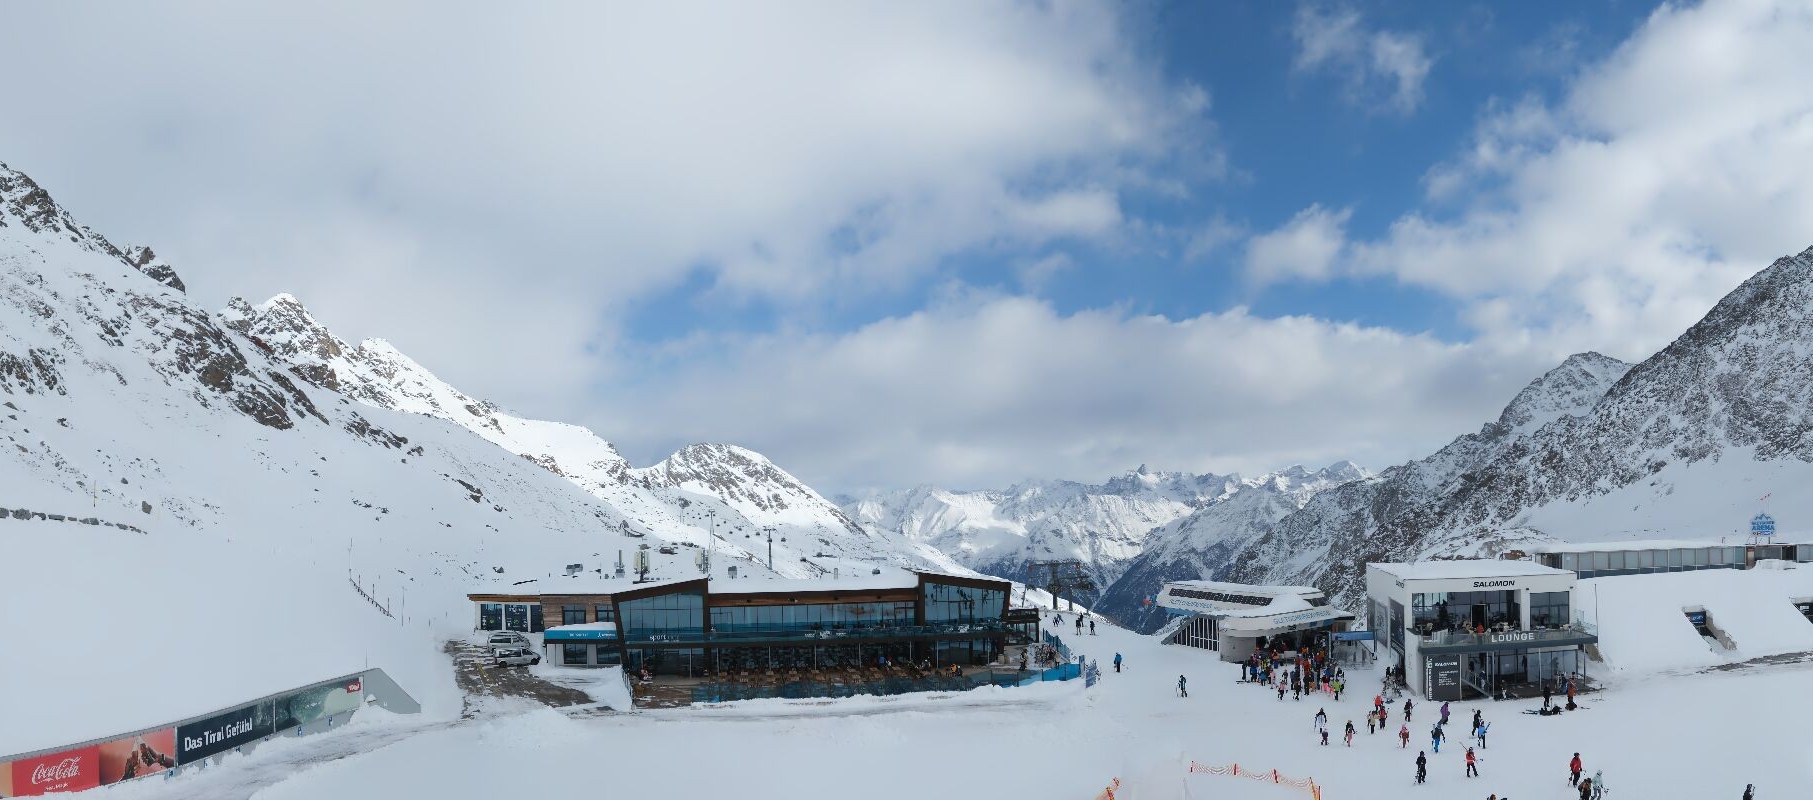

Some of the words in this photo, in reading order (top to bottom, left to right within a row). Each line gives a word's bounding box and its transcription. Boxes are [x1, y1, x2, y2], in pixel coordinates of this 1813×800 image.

[1473, 580, 1515, 588] SALOMON
[1491, 632, 1535, 643] LOUNGE
[184, 736, 203, 752] Das
[204, 726, 225, 746] Tirol
[226, 717, 253, 739] Gefühl
[32, 756, 82, 785] Coca-Cola
